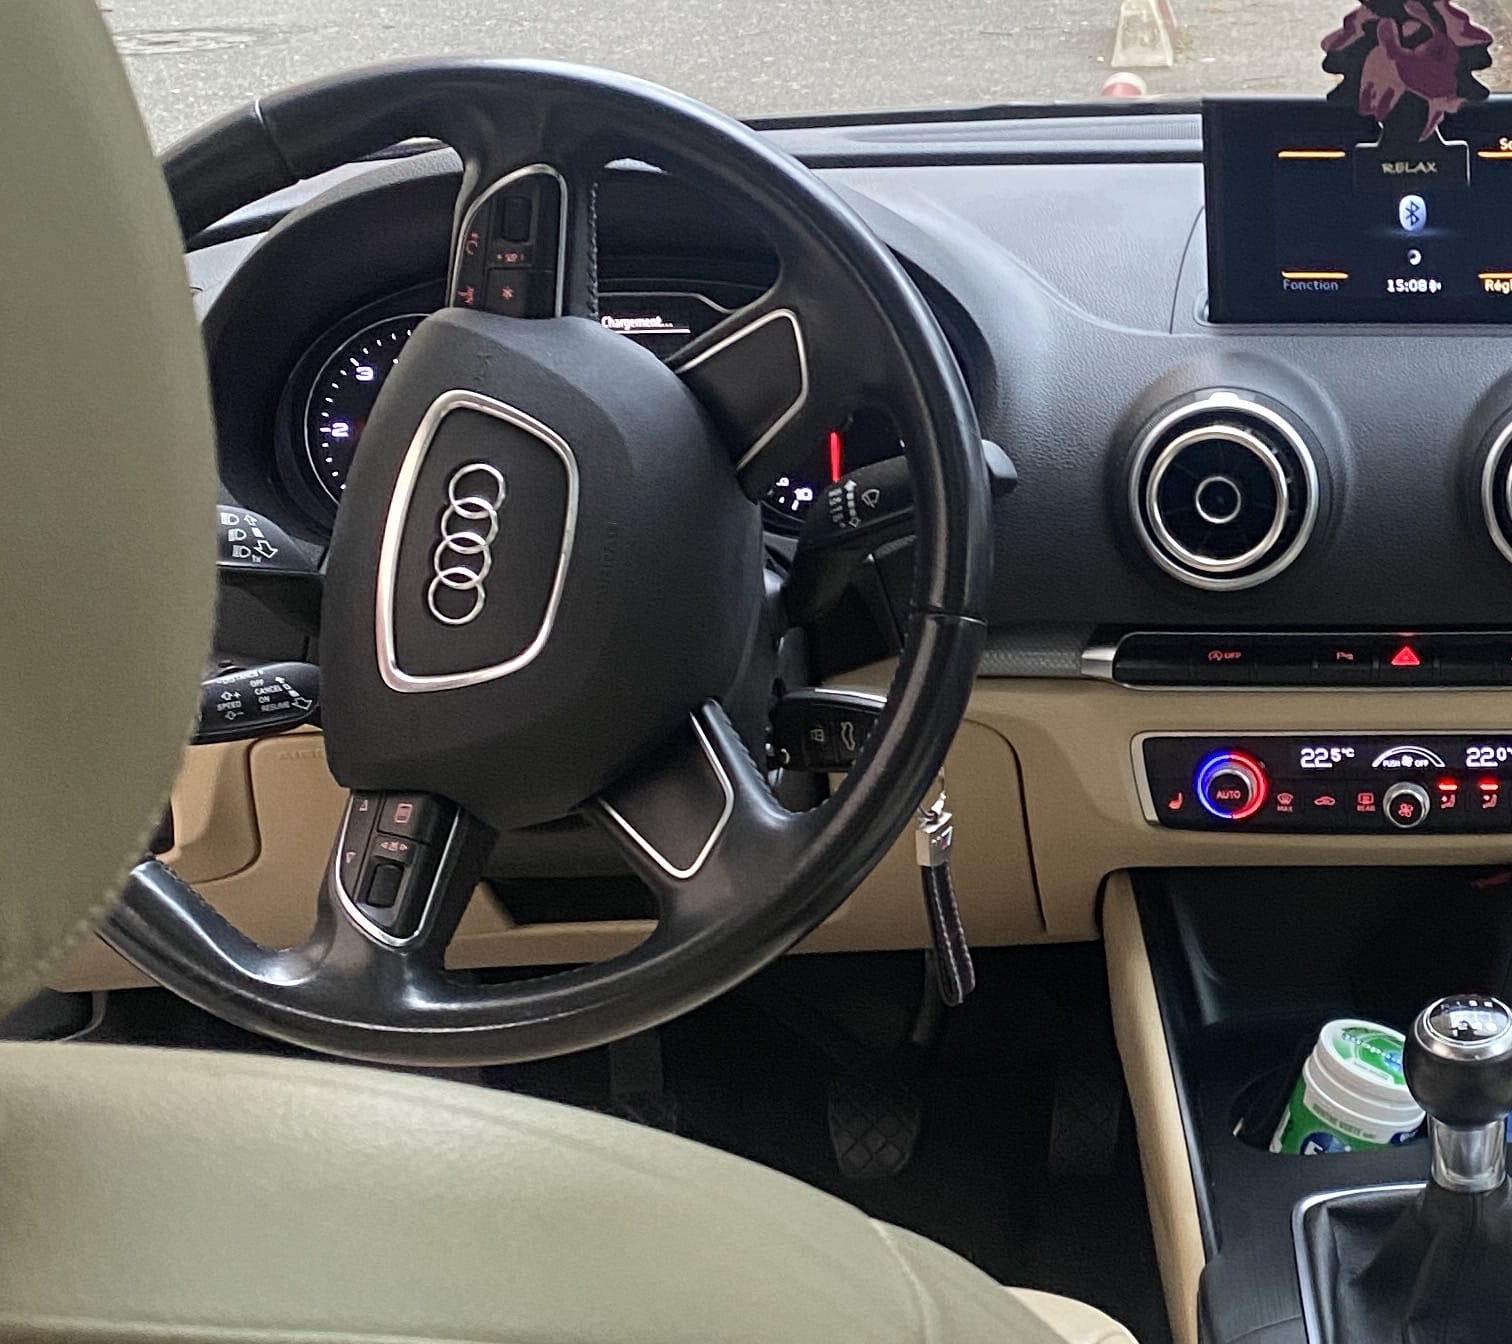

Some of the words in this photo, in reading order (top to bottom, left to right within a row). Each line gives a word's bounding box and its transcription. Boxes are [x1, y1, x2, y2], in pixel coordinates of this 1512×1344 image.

[1381, 162, 1437, 174] RELAX
[1283, 279, 1338, 291] Fonction
[1387, 278, 1427, 293] 15:08
[356, 366, 374, 381] 3
[331, 422, 349, 437] 2
[250, 679, 264, 687] OFF
[254, 684, 283, 696] CANCEL
[259, 695, 270, 703] ON
[1216, 790, 1241, 800] AUTO
